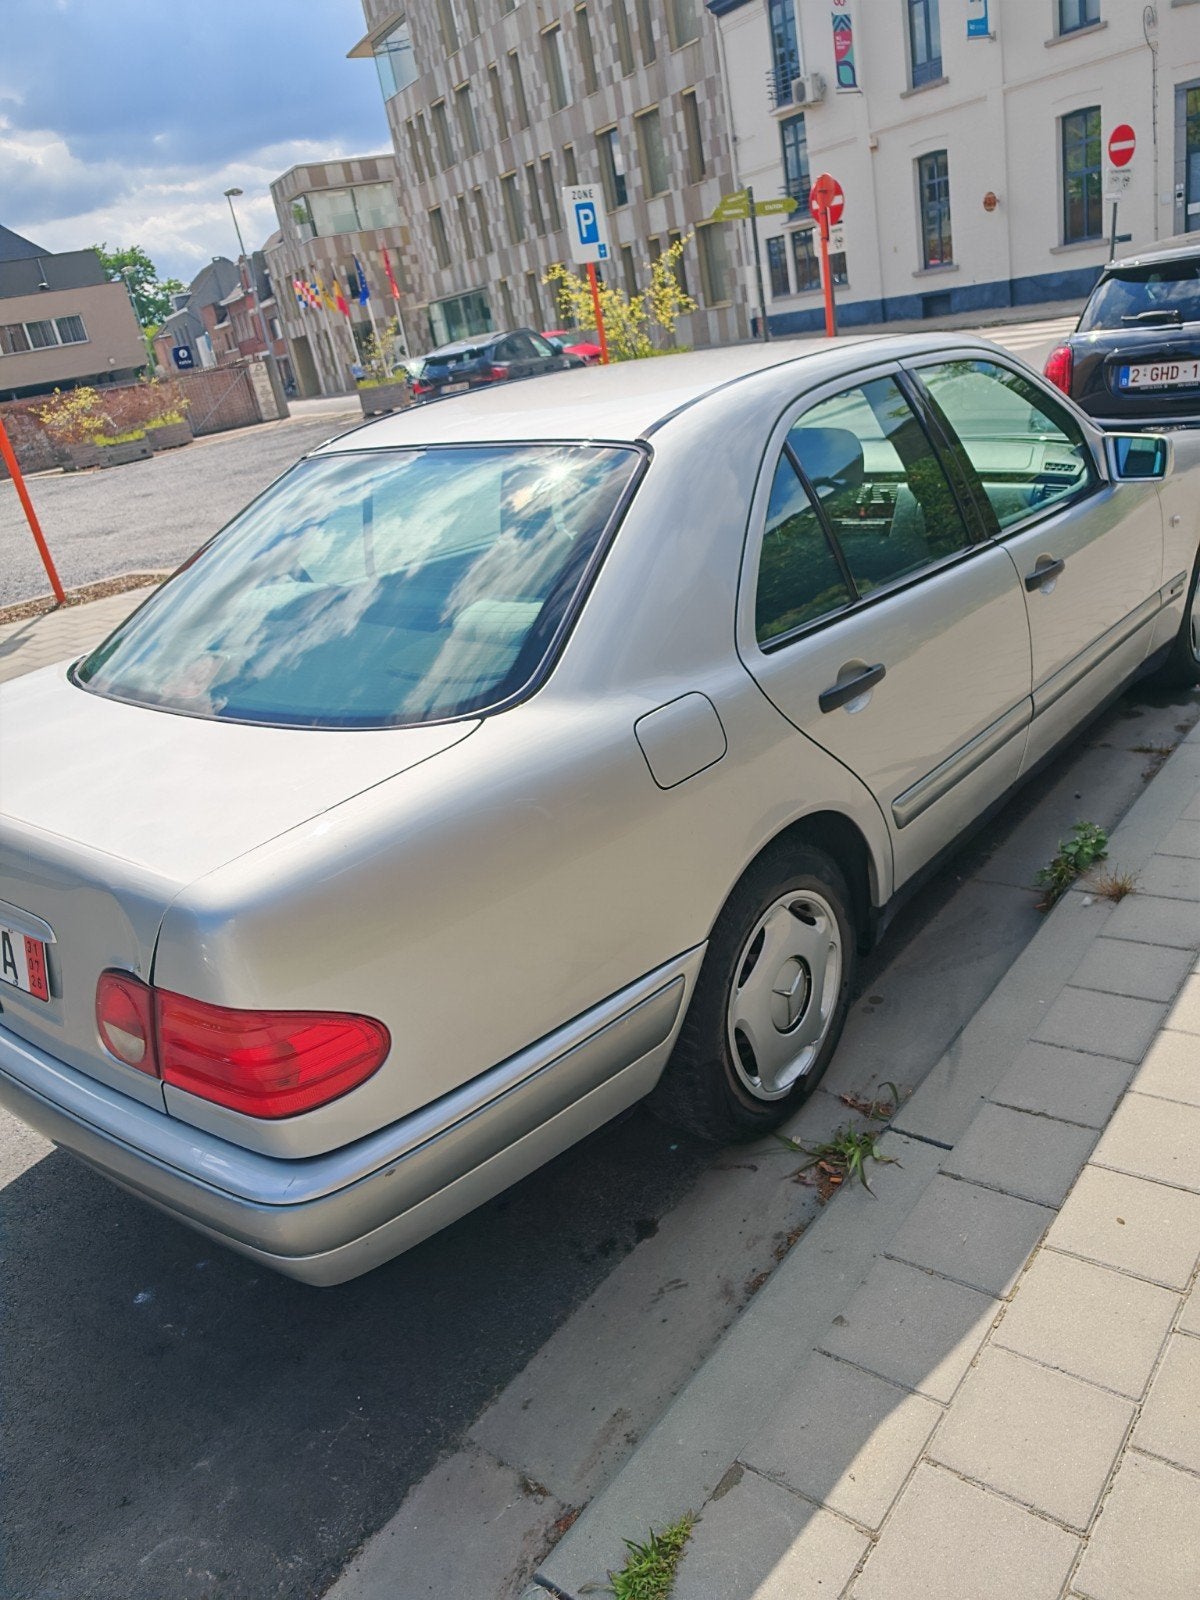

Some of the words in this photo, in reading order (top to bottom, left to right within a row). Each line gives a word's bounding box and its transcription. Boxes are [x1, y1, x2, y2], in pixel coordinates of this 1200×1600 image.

[572, 189, 594, 200] ZONE
[578, 209, 594, 238] P
[2, 931, 18, 979] A
